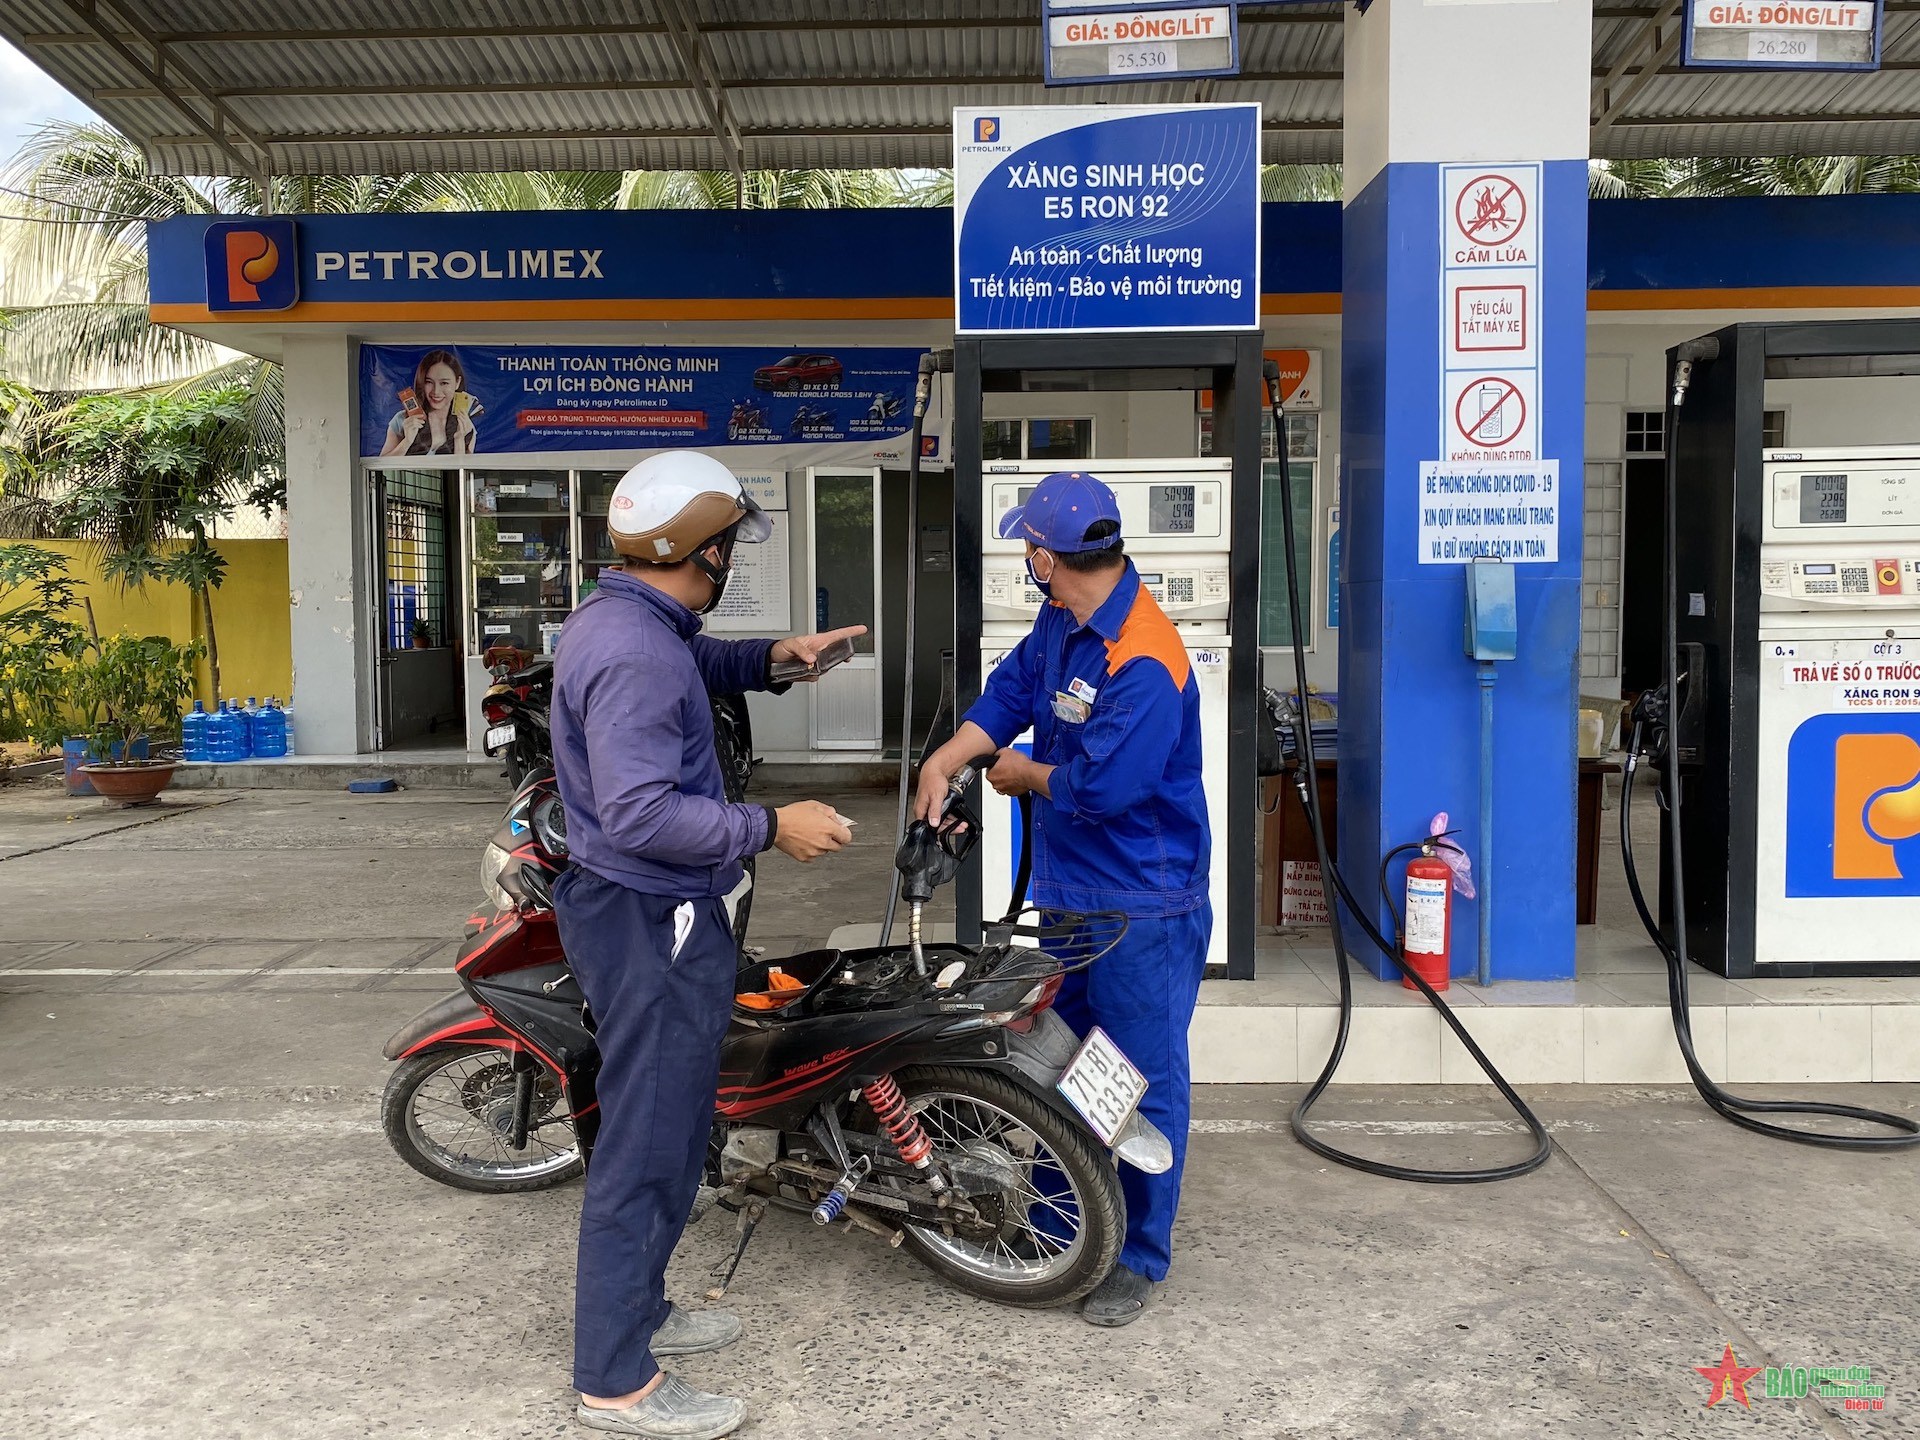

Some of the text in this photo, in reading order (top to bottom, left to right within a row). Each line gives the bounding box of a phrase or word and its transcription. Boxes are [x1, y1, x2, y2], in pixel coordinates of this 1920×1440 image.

[1709, 1, 1859, 26] GIÁ: ĐỒNG/LÍT
[1066, 14, 1214, 41] GIÁ: ĐỒNG/LÍT
[1757, 40, 1806, 55] 26.280
[1117, 52, 1166, 68] 25.530
[1007, 161, 1205, 192] XĂNG SINH HỌC
[1044, 195, 1168, 219] E5 RON 92
[1009, 240, 1202, 267] An toàn Chất lượng
[1455, 245, 1527, 263] CẤM LỬA
[315, 249, 605, 281] PETROLIMEX
[970, 273, 1242, 302] Tiết kiệm Bảo vệ môi trường
[1470, 298, 1513, 316] YÊU CẦU
[1462, 316, 1520, 334] TẮT MÁY XE
[497, 355, 719, 372] THANH TOÁN THÔNG MINH
[523, 375, 693, 395] LỢI ÍCH ĐỒNG HÀNH
[557, 398, 578, 408] Đăng
[580, 399, 590, 408] ký
[614, 399, 657, 407] Petrolimex
[1426, 467, 1552, 497] ĐỂ PHÒNG CHỐNG DỊCH COVID 19
[1424, 498, 1554, 529] XIN QUÝ KHÁCH MANG KHẨU TRANG
[1169, 520, 1193, 529] 25530
[1432, 534, 1545, 559] VÀ GIỮ KHOẢNG CÁCH AN TOÀN
[1895, 645, 1902, 654] 3
[1793, 662, 1819, 682] TRẢ
[1822, 662, 1839, 681] VỀ
[1843, 661, 1863, 681] SỐ
[1877, 661, 1920, 680] TRƯỚC
[1844, 687, 1879, 698] XĂNG
[1883, 689, 1909, 698] RON
